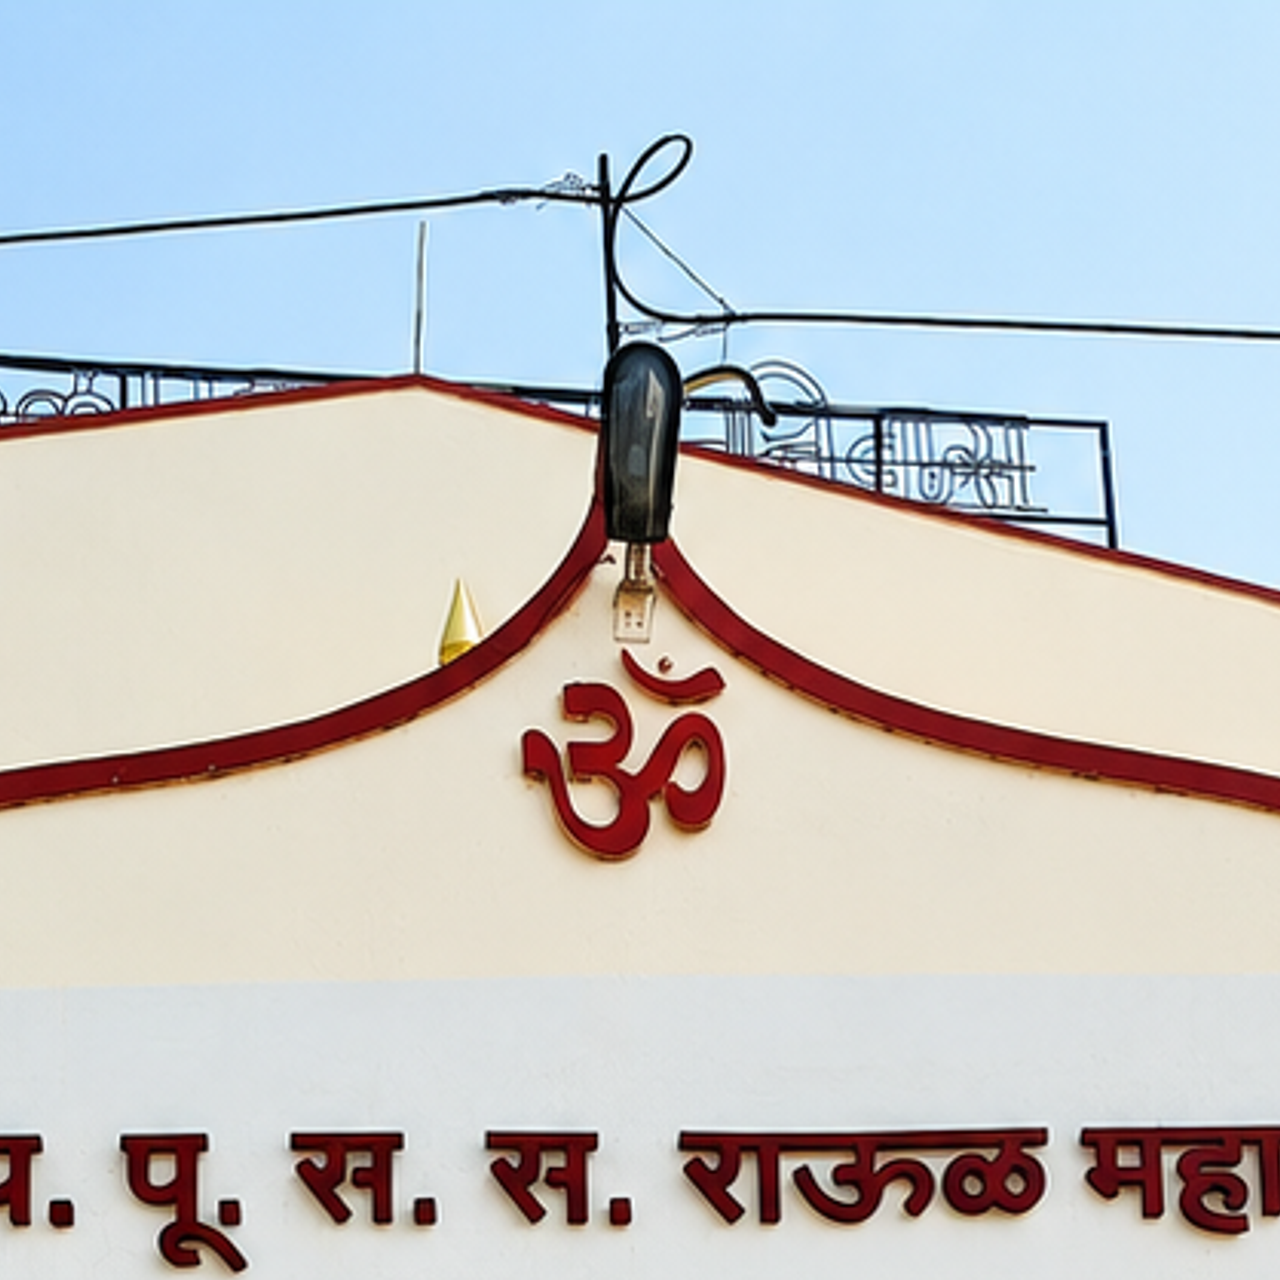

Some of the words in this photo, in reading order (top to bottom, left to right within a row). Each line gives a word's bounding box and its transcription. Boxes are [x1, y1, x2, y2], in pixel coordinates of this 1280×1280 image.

[119, 1133, 248, 1274] पू.
[289, 1132, 437, 1227] स.
[484, 1130, 632, 1227] स.
[677, 1127, 1049, 1226] राऊळ
